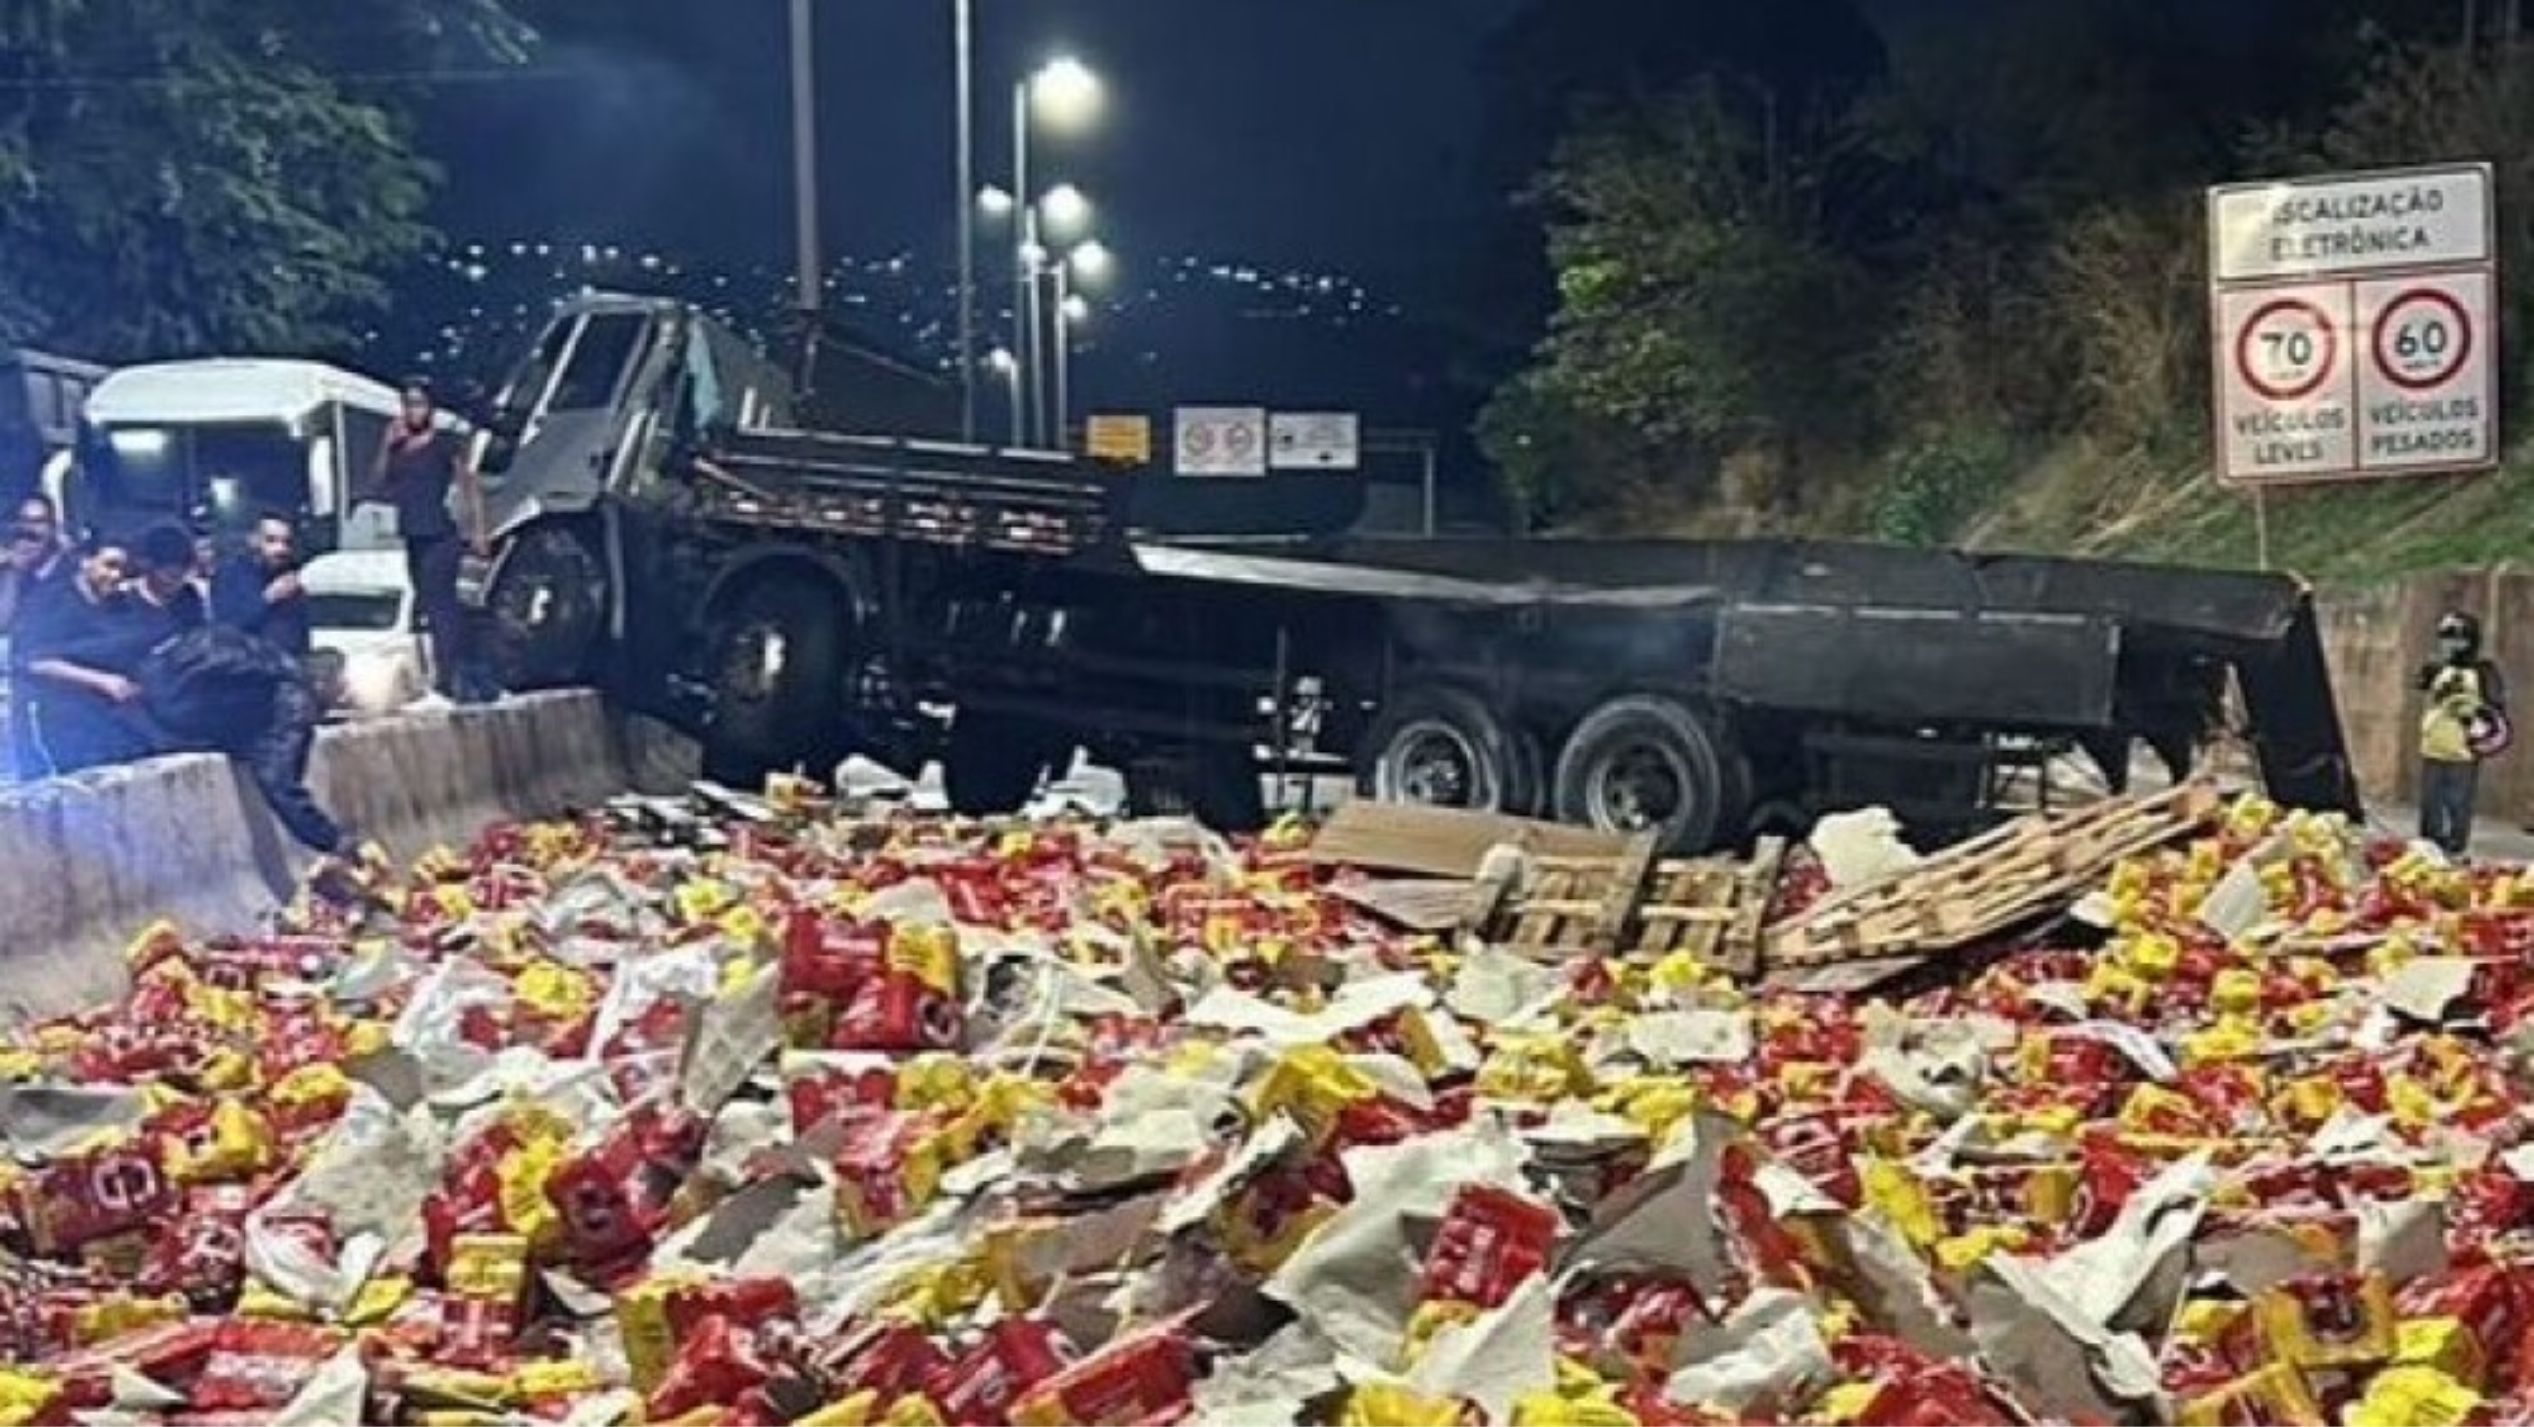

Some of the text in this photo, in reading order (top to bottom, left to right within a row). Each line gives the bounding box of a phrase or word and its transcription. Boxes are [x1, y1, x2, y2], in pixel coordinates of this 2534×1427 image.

[2272, 185, 2444, 225] SCALIZAÇÃO
[2271, 224, 2430, 261] ELETRÔNICA
[2260, 331, 2312, 365] 70
[2396, 321, 2446, 357] 60
[2255, 440, 2324, 464] LEVES
[2371, 428, 2475, 456] PESADOS
